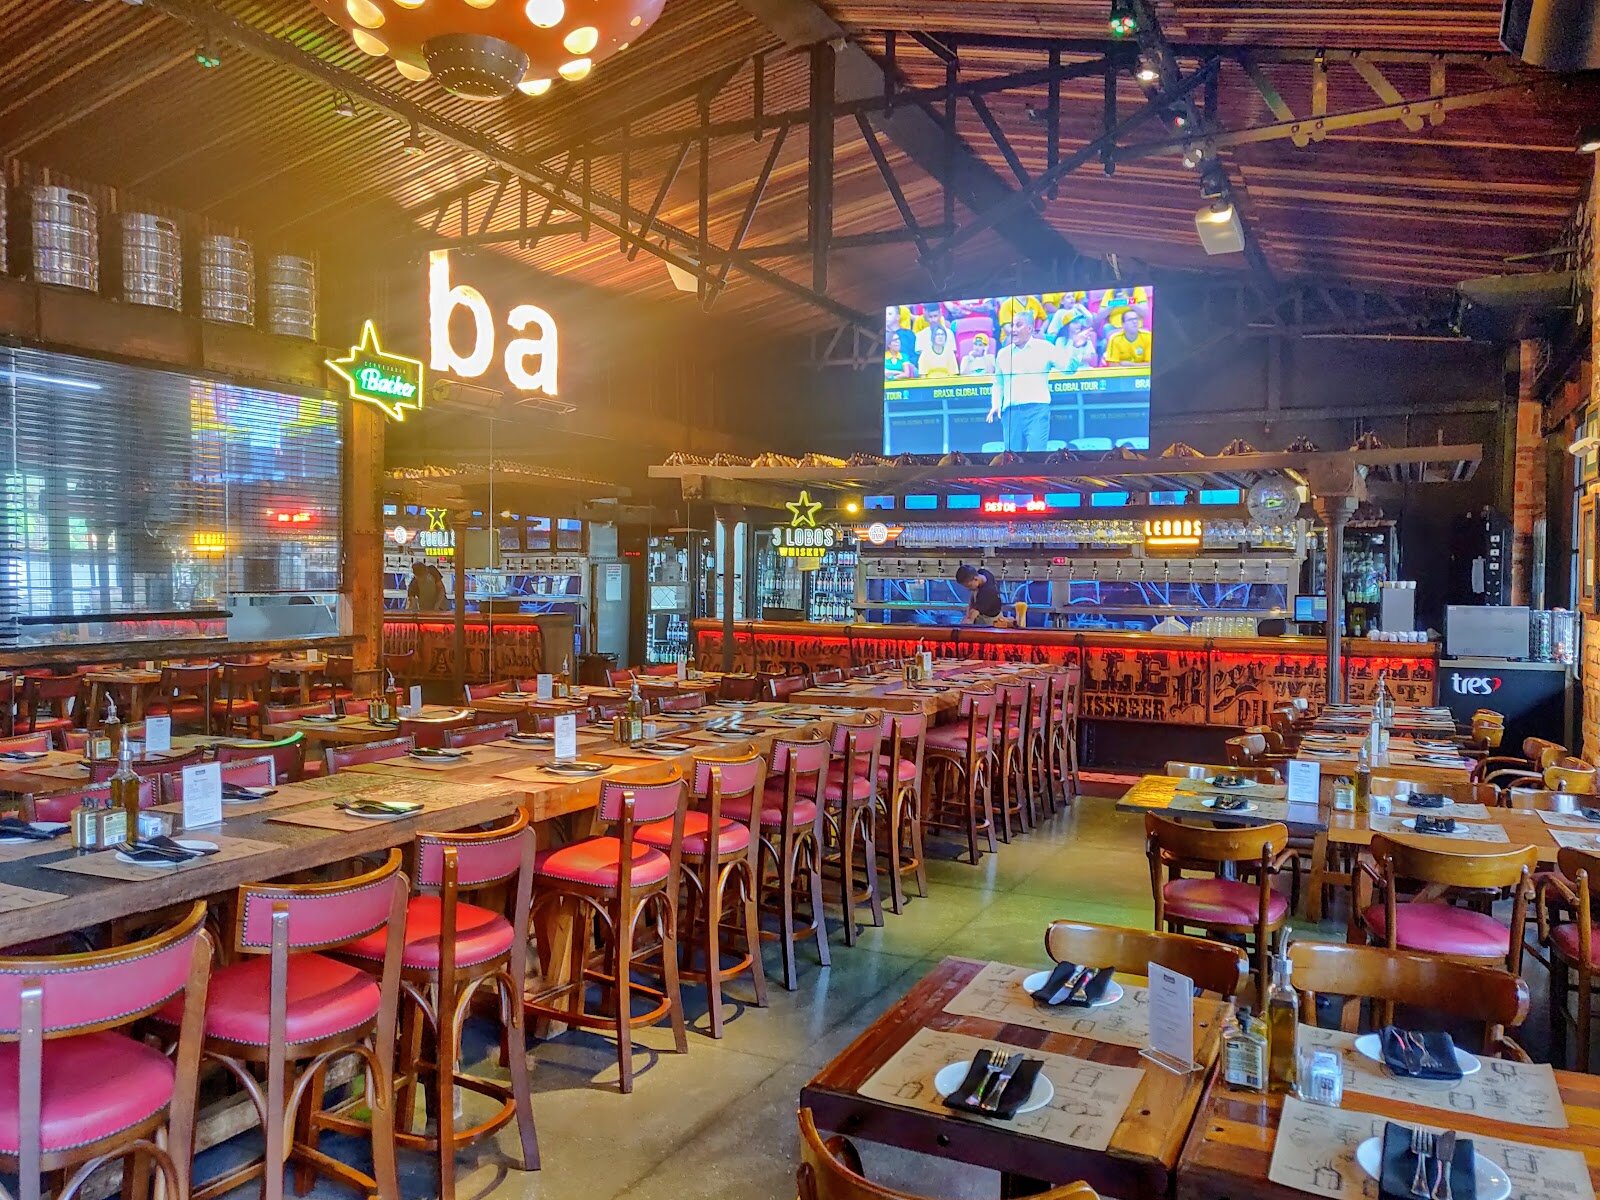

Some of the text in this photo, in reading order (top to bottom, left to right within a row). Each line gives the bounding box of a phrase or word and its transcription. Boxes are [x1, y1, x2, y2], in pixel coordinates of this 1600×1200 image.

[429, 249, 559, 396] ba
[933, 386, 993, 399] BRASIL GLOBAL TOU
[1054, 382, 1080, 392] GLOBAL
[1080, 380, 1099, 391] TOUR
[886, 391, 903, 400] TOUR
[772, 527, 834, 547] 3 LOBOS
[778, 547, 826, 557] WHISKEY
[1451, 672, 1494, 695] tres
